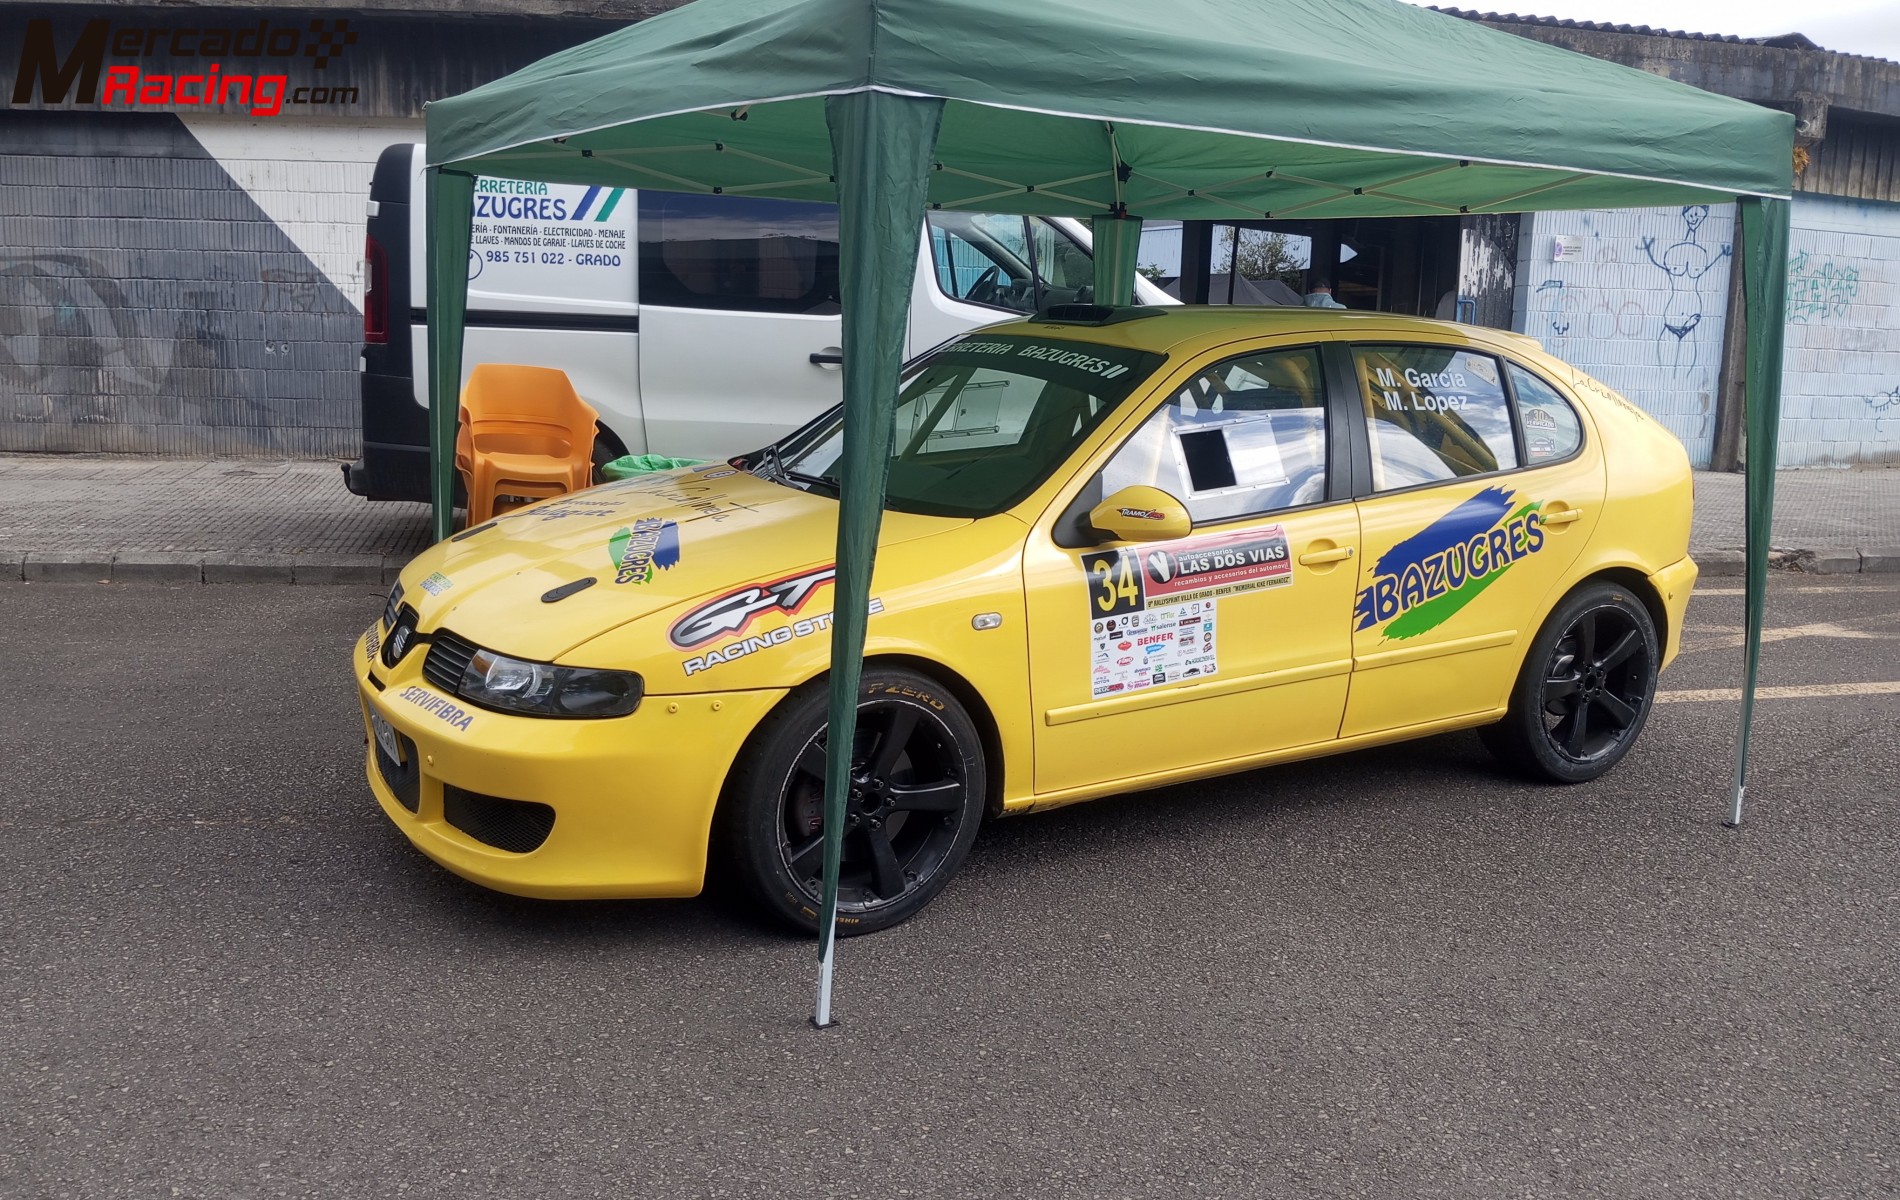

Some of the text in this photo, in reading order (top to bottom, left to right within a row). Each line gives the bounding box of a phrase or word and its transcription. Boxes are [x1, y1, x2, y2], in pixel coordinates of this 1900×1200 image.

[475, 235, 500, 245] LLAVES
[504, 236, 532, 246] MANDOS
[533, 238, 542, 247] DE
[542, 238, 567, 248] GARAJE
[571, 239, 595, 249] LLAVES
[595, 240, 604, 249] DE
[605, 240, 626, 250] COCHE
[543, 227, 593, 238] ELECTRICIDAD
[598, 229, 626, 239] MENAJE
[486, 250, 621, 267] 985 751 022 GRADO
[1017, 345, 1110, 373] BAZUGRES
[1375, 367, 1401, 387] M.
[1382, 390, 1470, 415] M. Lopez
[1178, 548, 1234, 562] autoaccesorios
[1179, 546, 1285, 575] LAS DOS VIAS
[1374, 511, 1545, 622] BAZUGRES
[1093, 555, 1139, 612] 34
[1174, 577, 1207, 587] recambios
[1213, 570, 1248, 580] accesorios
[1248, 566, 1258, 574] del
[682, 597, 885, 676] RACING STE
[1137, 632, 1174, 646] BENFER
[399, 685, 474, 733] SERVIFIBRA
